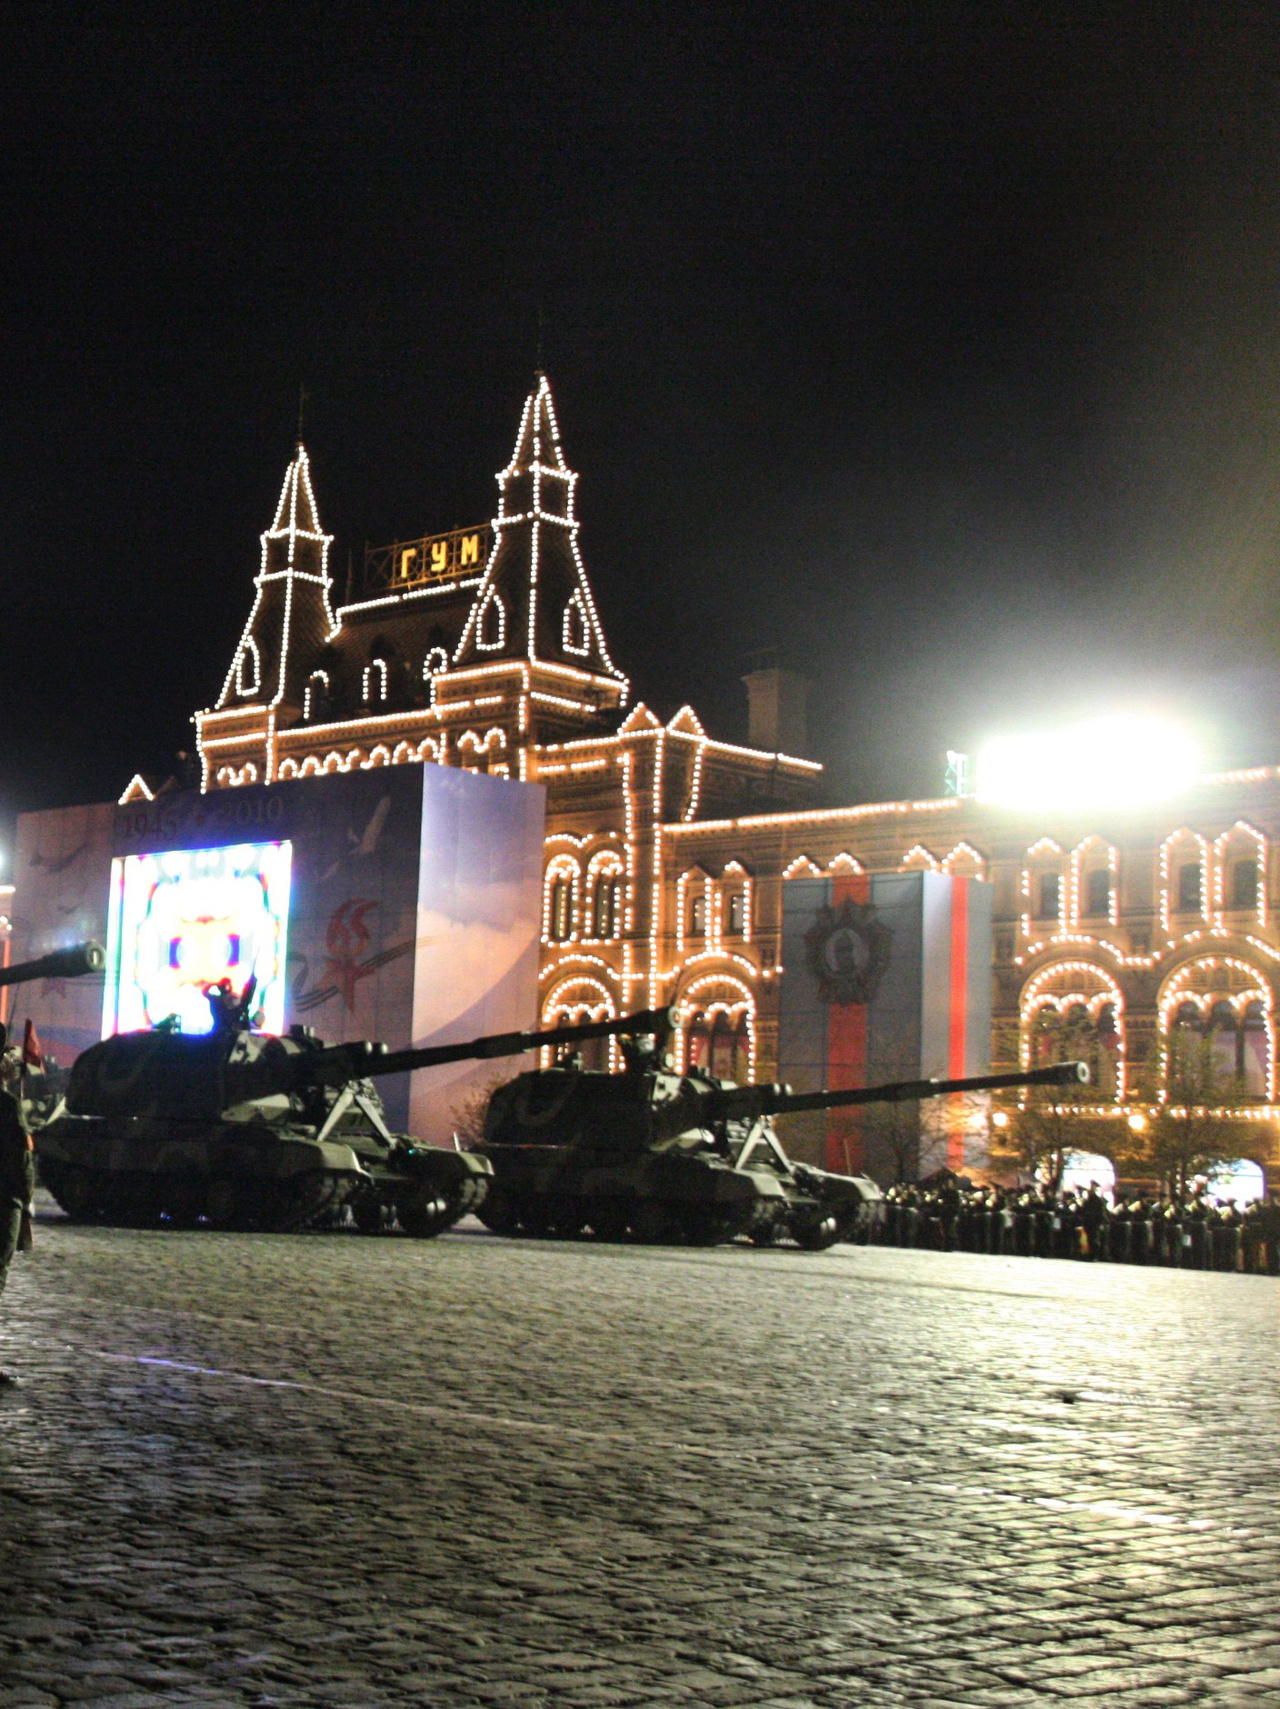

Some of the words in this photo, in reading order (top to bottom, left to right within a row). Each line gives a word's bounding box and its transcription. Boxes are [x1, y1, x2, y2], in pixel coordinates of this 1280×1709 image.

[401, 534, 479, 578] ГУМ
[123, 808, 178, 842] 1945
[218, 795, 283, 826] 2010
